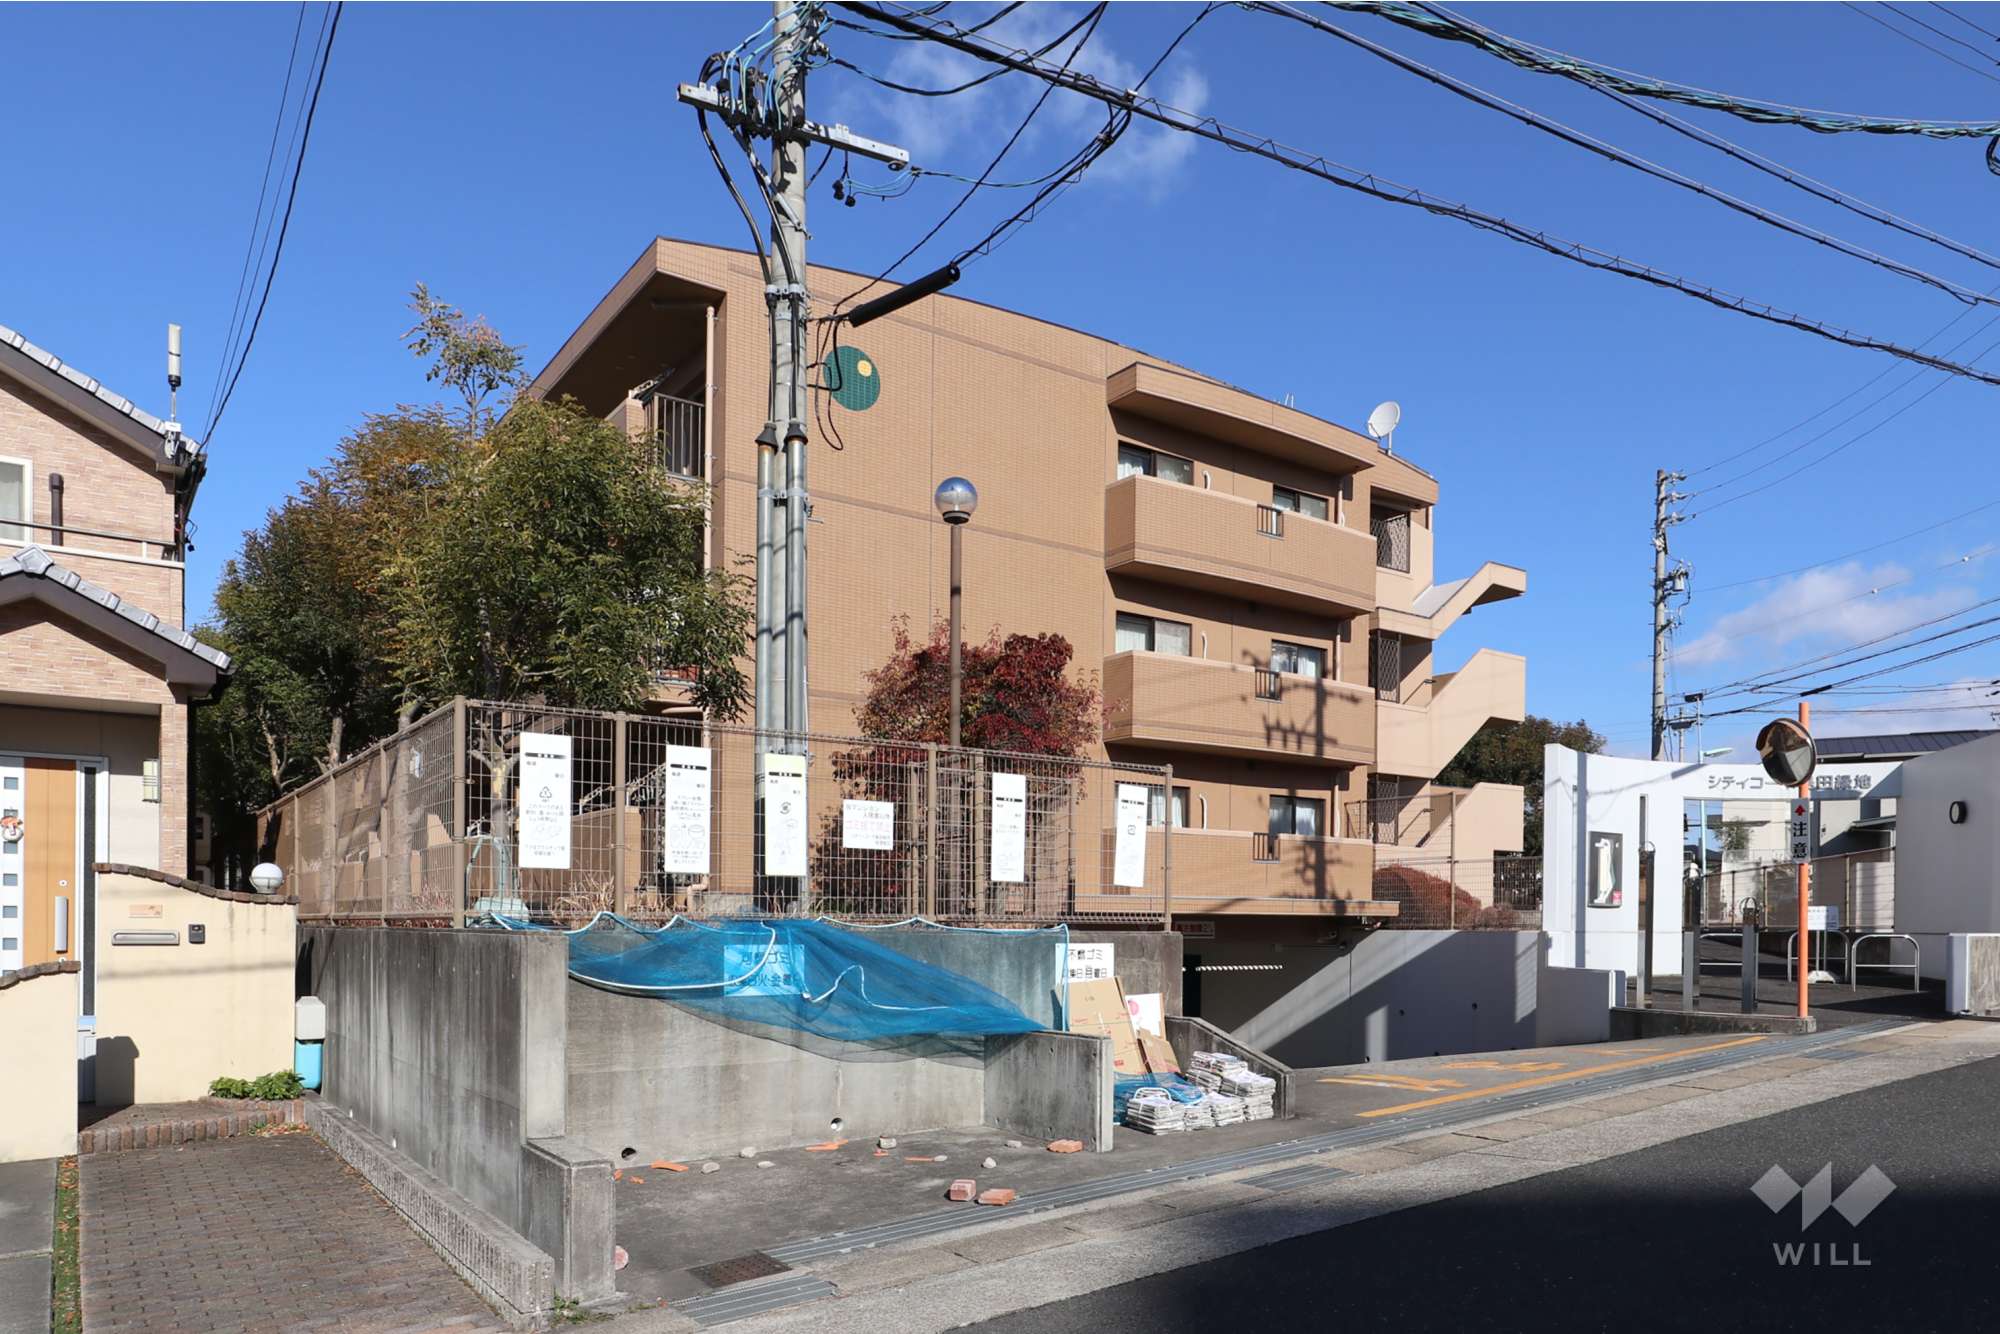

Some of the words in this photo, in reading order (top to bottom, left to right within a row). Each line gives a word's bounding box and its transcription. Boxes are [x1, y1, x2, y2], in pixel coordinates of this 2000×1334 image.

[1708, 775, 1871, 790] シティコー田緑地
[1793, 821, 1808, 858] 注意
